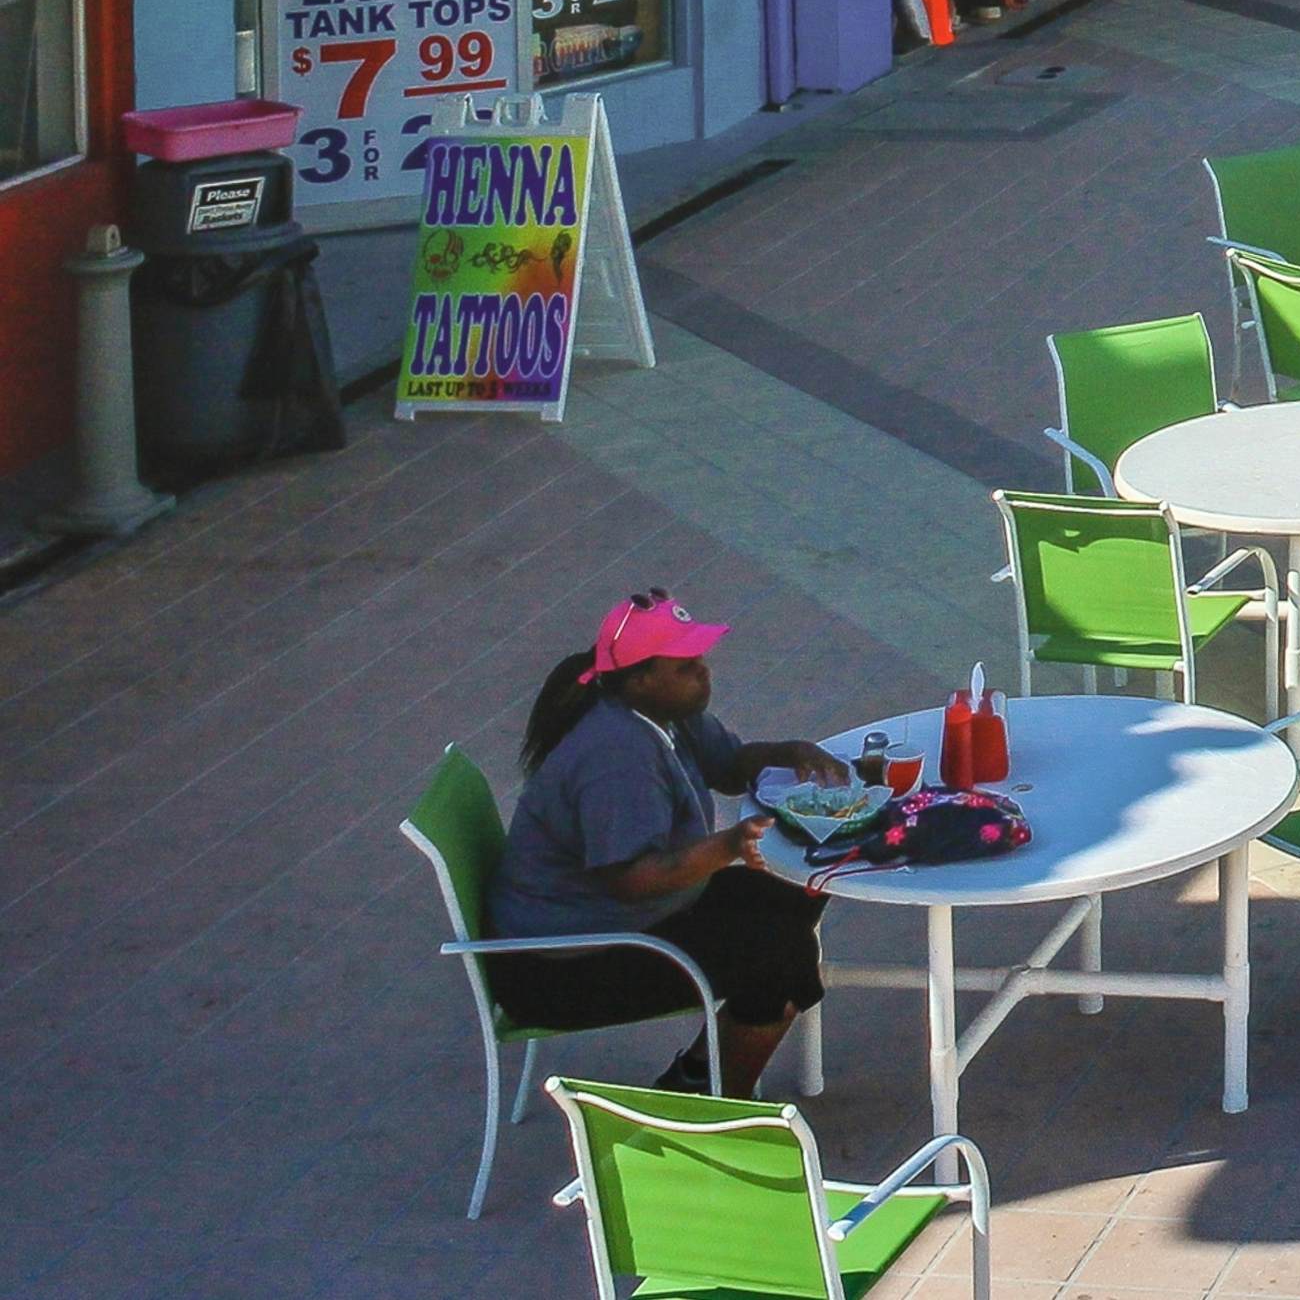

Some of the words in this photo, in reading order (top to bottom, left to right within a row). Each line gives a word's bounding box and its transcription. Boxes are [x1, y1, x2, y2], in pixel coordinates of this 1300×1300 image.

[286, 4, 398, 40] TANK
[299, 128, 352, 183] 3
[364, 130, 379, 181] FOR
[206, 188, 250, 202] Please
[424, 144, 577, 227] HENNA
[410, 291, 567, 378] TATTOOS
[408, 381, 443, 397] LAST
[445, 381, 464, 397] UP
